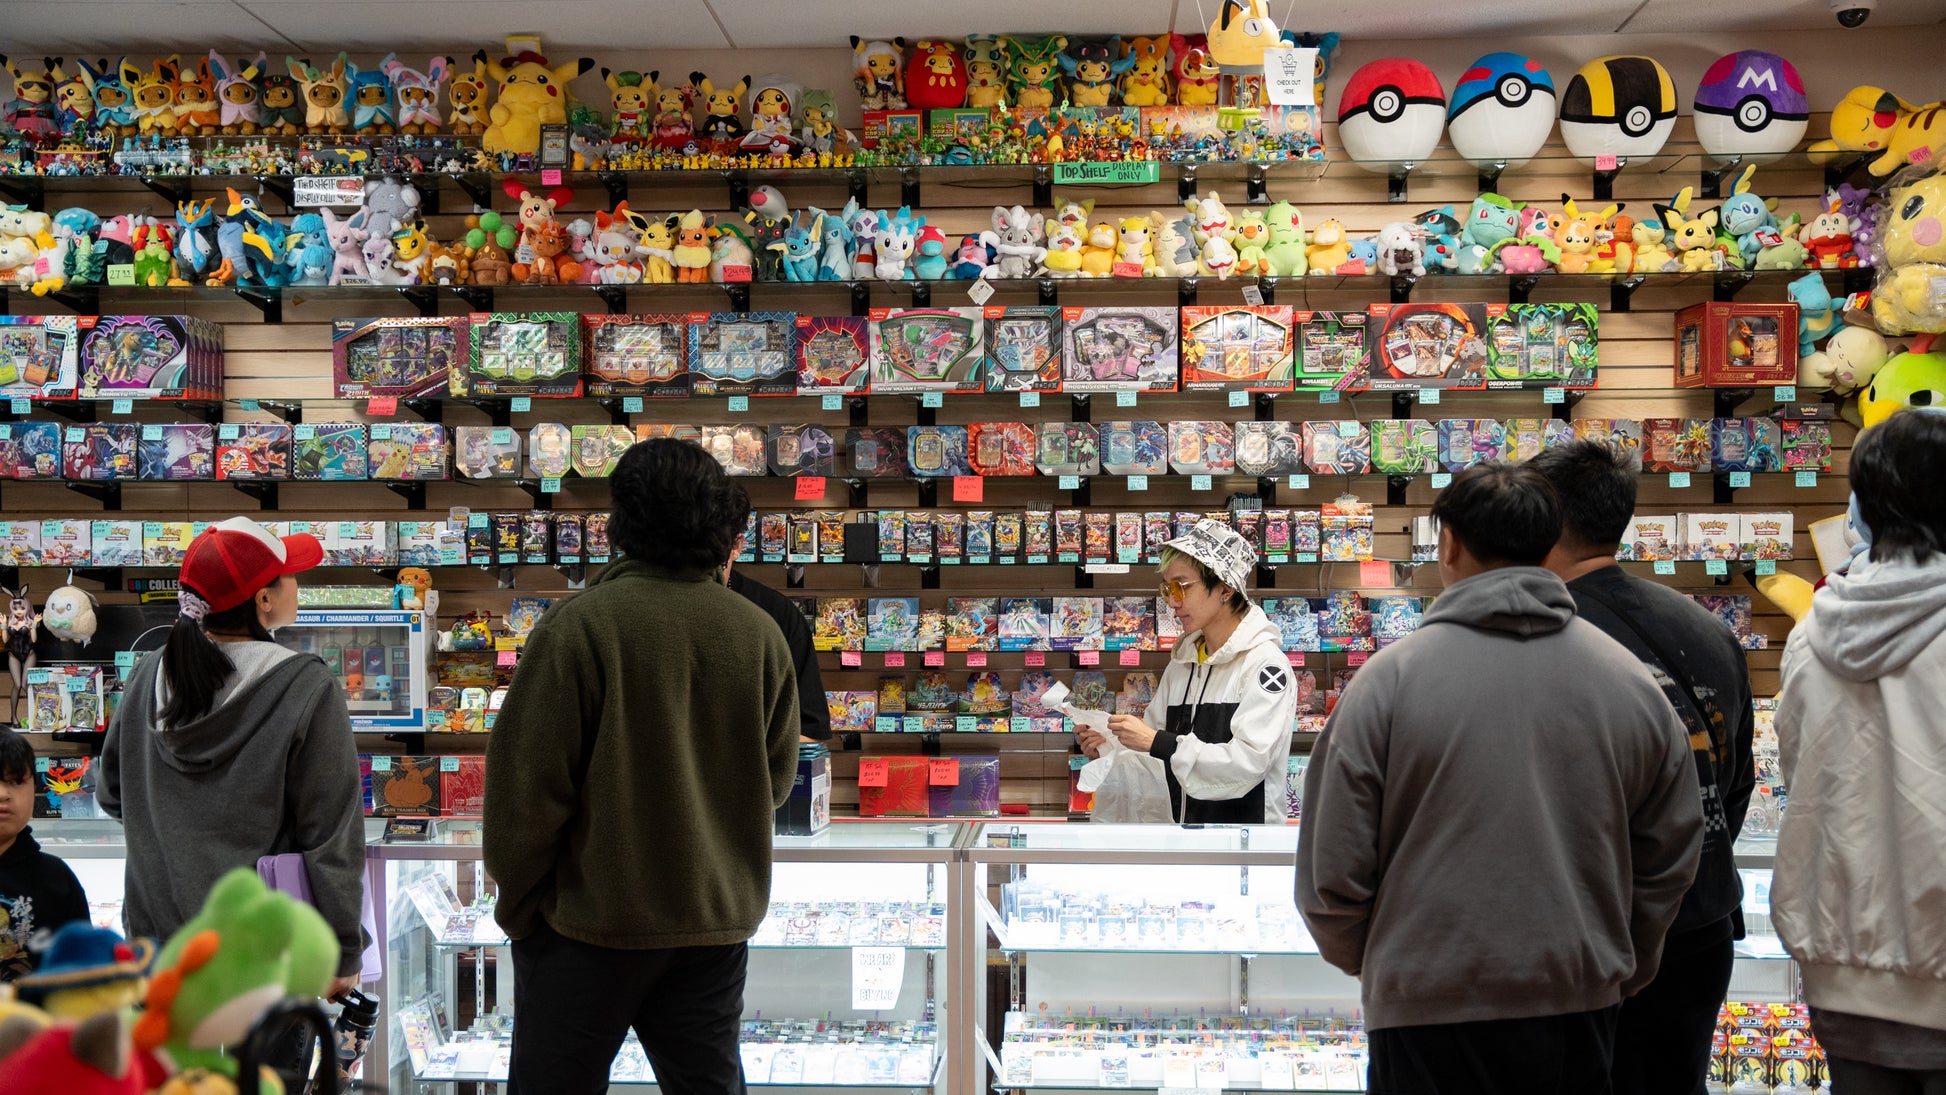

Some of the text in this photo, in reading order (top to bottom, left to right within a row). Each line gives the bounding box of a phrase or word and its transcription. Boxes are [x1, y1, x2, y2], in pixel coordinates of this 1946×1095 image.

[1057, 163, 1110, 179] TOP SHELF
[1113, 162, 1146, 171] DISPLAY
[1118, 172, 1140, 180] ONLY
[1636, 521, 1664, 531] Pokémon
[1699, 520, 1728, 530] Pokémon
[1752, 520, 1781, 530] Pokémon
